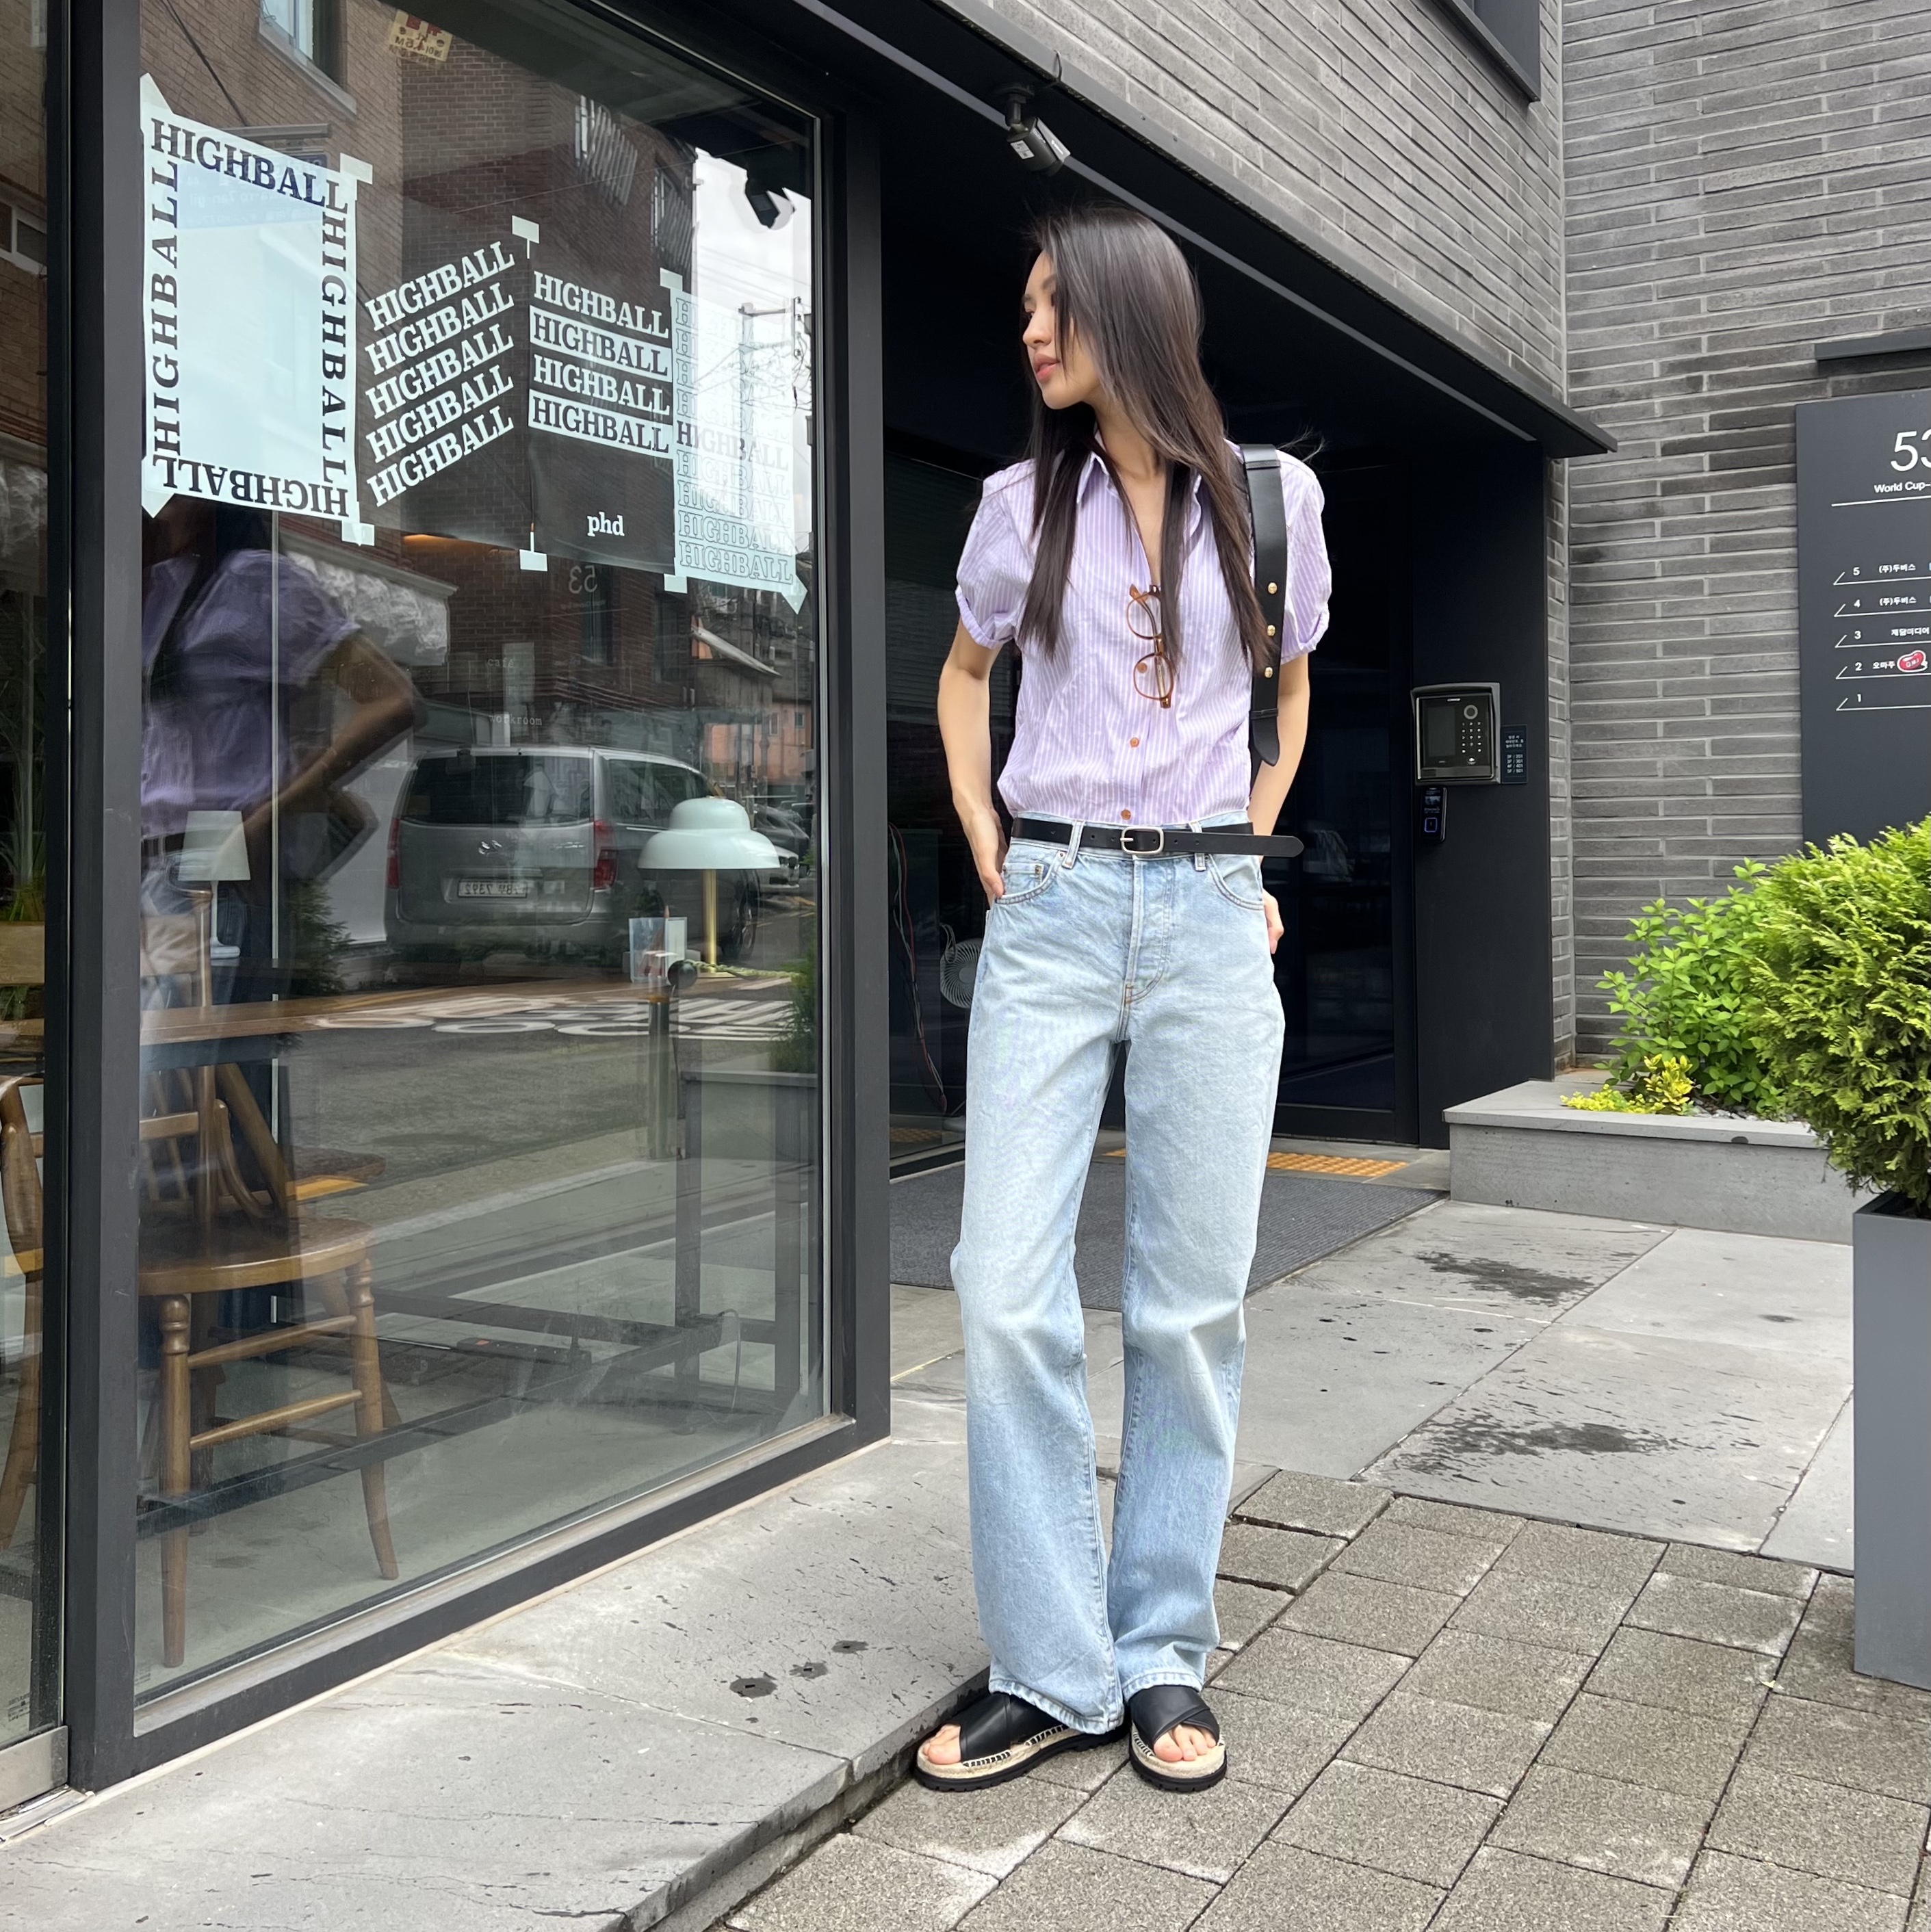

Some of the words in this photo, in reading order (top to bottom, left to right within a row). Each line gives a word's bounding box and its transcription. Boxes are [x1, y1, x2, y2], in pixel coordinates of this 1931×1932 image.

[151, 118, 348, 213] HIGHBALL
[152, 160, 181, 456] HIGHBALL
[365, 242, 515, 331] HIGHBALL
[534, 271, 669, 338] HIGHBALL
[322, 211, 348, 483] HIGHBALL
[365, 282, 514, 375] HIGHBALL
[534, 311, 668, 378] HIGHBALL
[365, 324, 514, 419] HIGHBALL
[534, 354, 670, 416] HIGHBALL
[366, 365, 514, 463] HIGHBALL
[532, 395, 669, 453] HIGHBALL
[153, 454, 349, 518] HIGHBALL
[366, 406, 514, 507] HIGHBALL
[1874, 482, 1902, 493] World
[587, 512, 625, 536] phd
[678, 510, 792, 557] HIGHBALL
[679, 540, 794, 585] HIGHBALL
[1853, 567, 1861, 576] 5
[1854, 599, 1861, 608] 4
[1854, 631, 1861, 640] 3
[1855, 662, 1862, 671] 2
[1873, 661, 1895, 669] 오마주
[1856, 694, 1861, 702] 1
